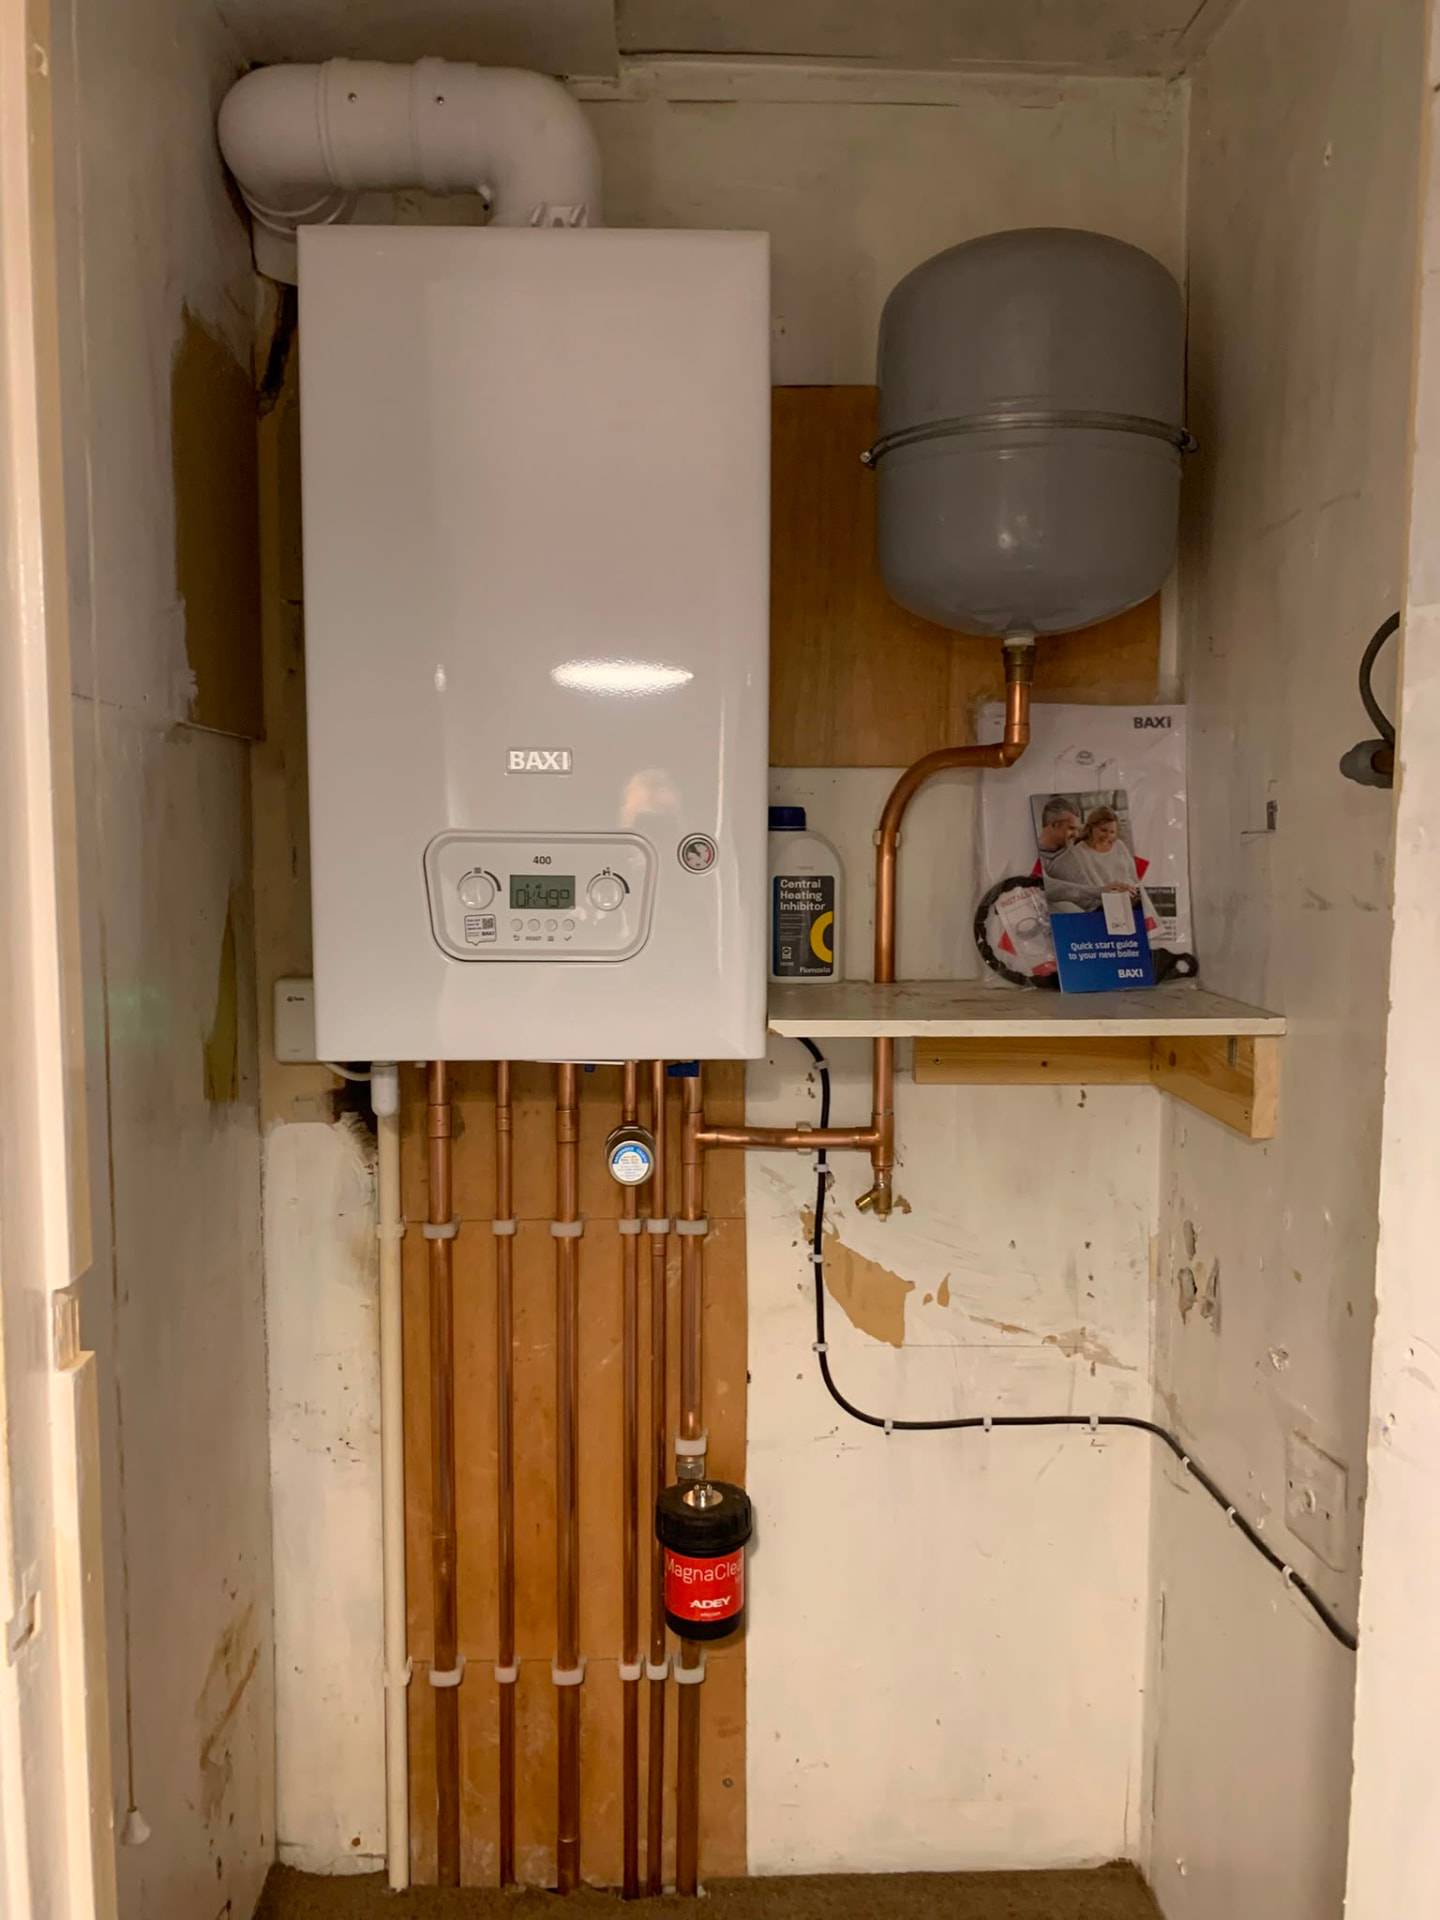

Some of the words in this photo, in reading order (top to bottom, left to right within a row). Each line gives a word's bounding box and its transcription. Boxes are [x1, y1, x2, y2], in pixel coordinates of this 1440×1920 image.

[509, 750, 569, 770] BAXI
[532, 855, 552, 865] 400
[780, 879, 821, 889] Central
[780, 890, 822, 902] Heating
[780, 901, 826, 911] Inhibitor
[1070, 942, 1093, 952] Quick
[1095, 941, 1115, 949] start
[1116, 940, 1138, 950] guide
[1068, 952, 1077, 960] to
[1079, 952, 1097, 961] your
[1117, 949, 1140, 958] boiler
[1117, 968, 1143, 978] BAXI
[664, 1557, 743, 1584] MagnaClea
[690, 1595, 731, 1609] ADEY
